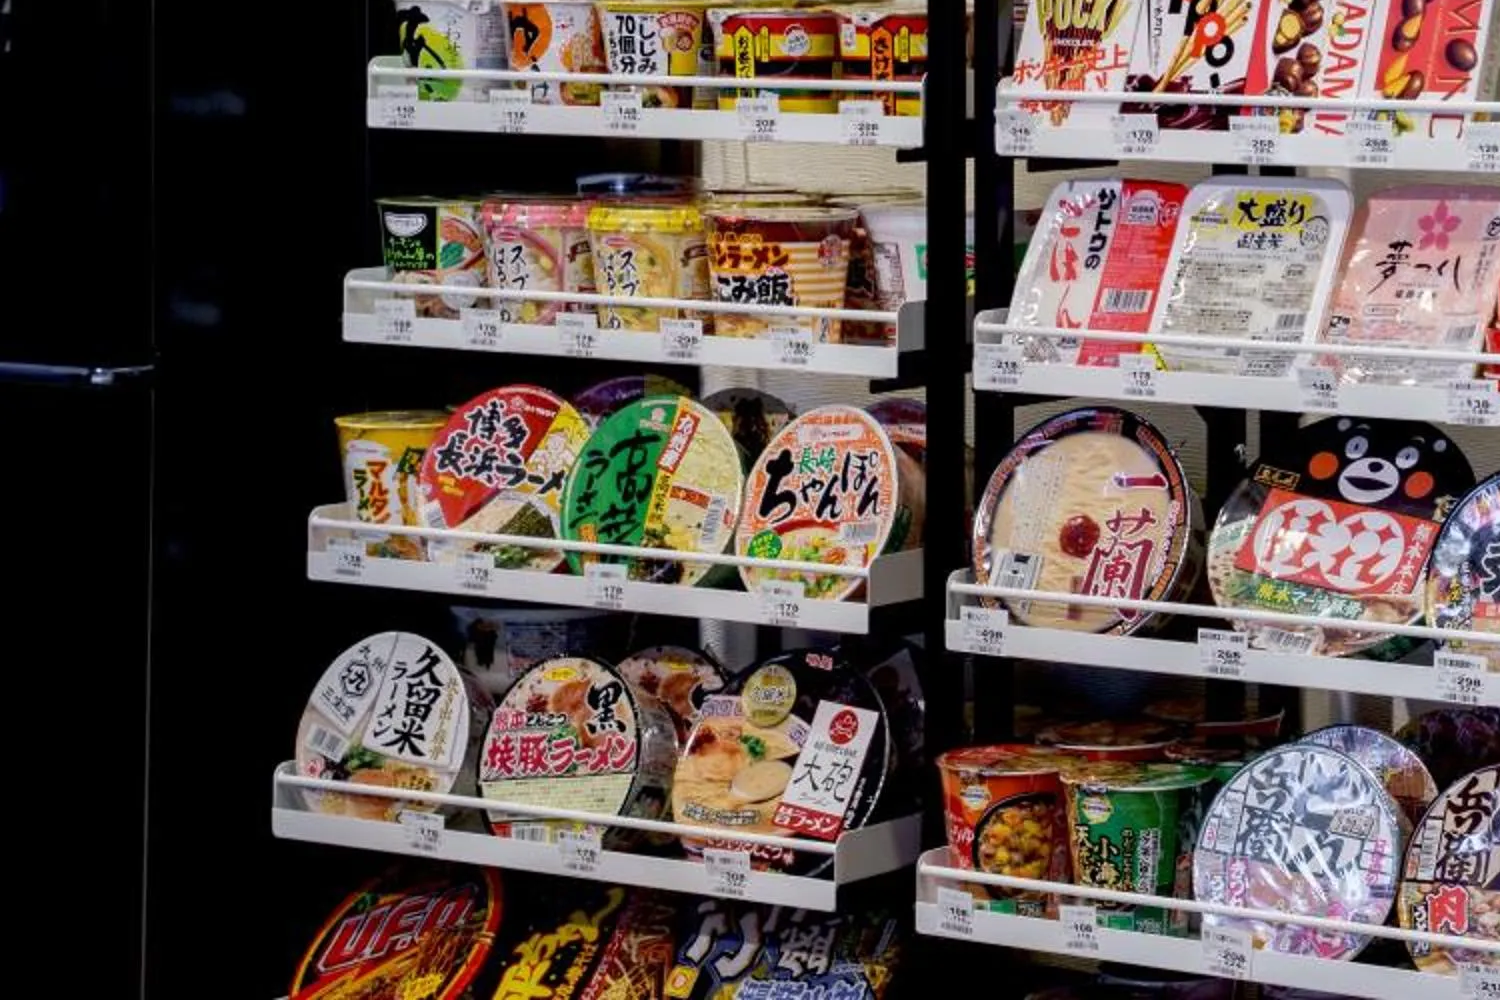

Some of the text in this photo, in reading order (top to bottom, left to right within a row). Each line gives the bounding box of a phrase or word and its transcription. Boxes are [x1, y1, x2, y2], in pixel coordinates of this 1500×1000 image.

[1236, 195, 1305, 227] 大盛り
[510, 244, 529, 291] スープ
[619, 250, 640, 297] スープ
[1367, 239, 1463, 295] 夢つくし
[435, 431, 566, 495] 長浜ラーメ
[372, 660, 408, 740] ラーメン
[389, 645, 444, 758] 久留米
[585, 680, 629, 735] 黒
[487, 732, 637, 777] 焼豚ラーメン
[793, 753, 855, 802] 大砲
